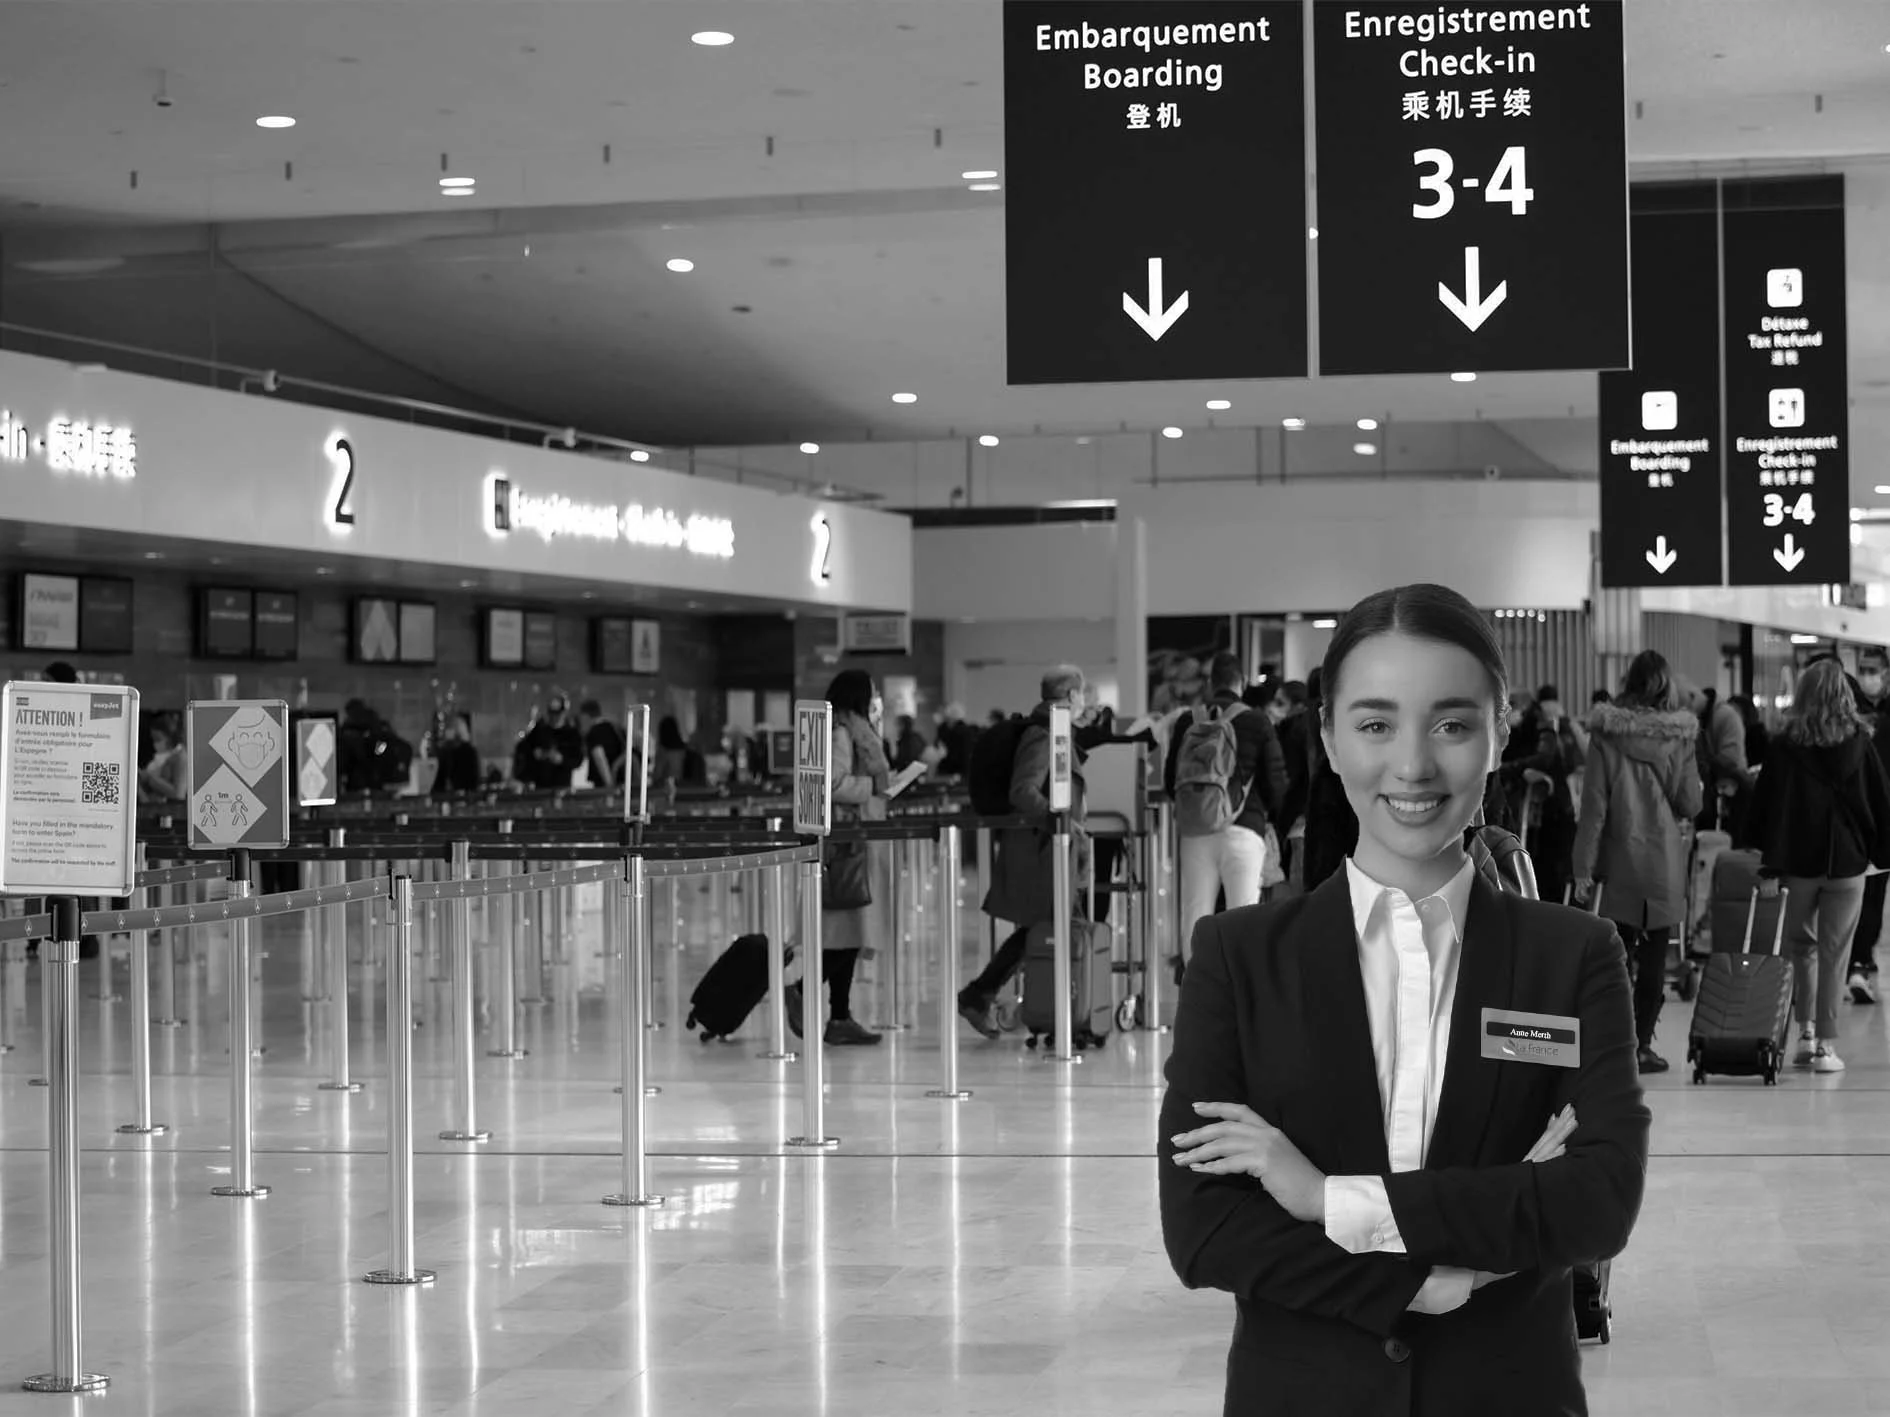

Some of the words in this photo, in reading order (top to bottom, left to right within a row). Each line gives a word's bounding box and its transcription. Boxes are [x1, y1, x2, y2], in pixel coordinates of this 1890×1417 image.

[1036, 17, 1271, 52] Embarquement
[1345, 4, 1591, 42] Enregistrement
[1084, 59, 1223, 91] Boarding
[1400, 46, 1536, 77] Check-in
[1126, 102, 1182, 129] 登机
[1402, 88, 1532, 120] 乘机手续
[1412, 146, 1535, 219] 3-4
[1748, 333, 1773, 349] Tax
[1774, 330, 1823, 348] Refund
[1610, 438, 1709, 456] Embarquement
[1736, 435, 1838, 455] Enregistrement
[1630, 455, 1691, 473] Boarding
[1757, 453, 1817, 469] Check-in
[327, 434, 355, 525] 2
[1763, 492, 1816, 527] 3-4
[16, 709, 76, 726] ATTENTION
[799, 711, 826, 767] EXIT
[798, 771, 825, 825] SORTIE
[79, 822, 114, 830] mandatory
[1509, 1028, 1530, 1038] Anne
